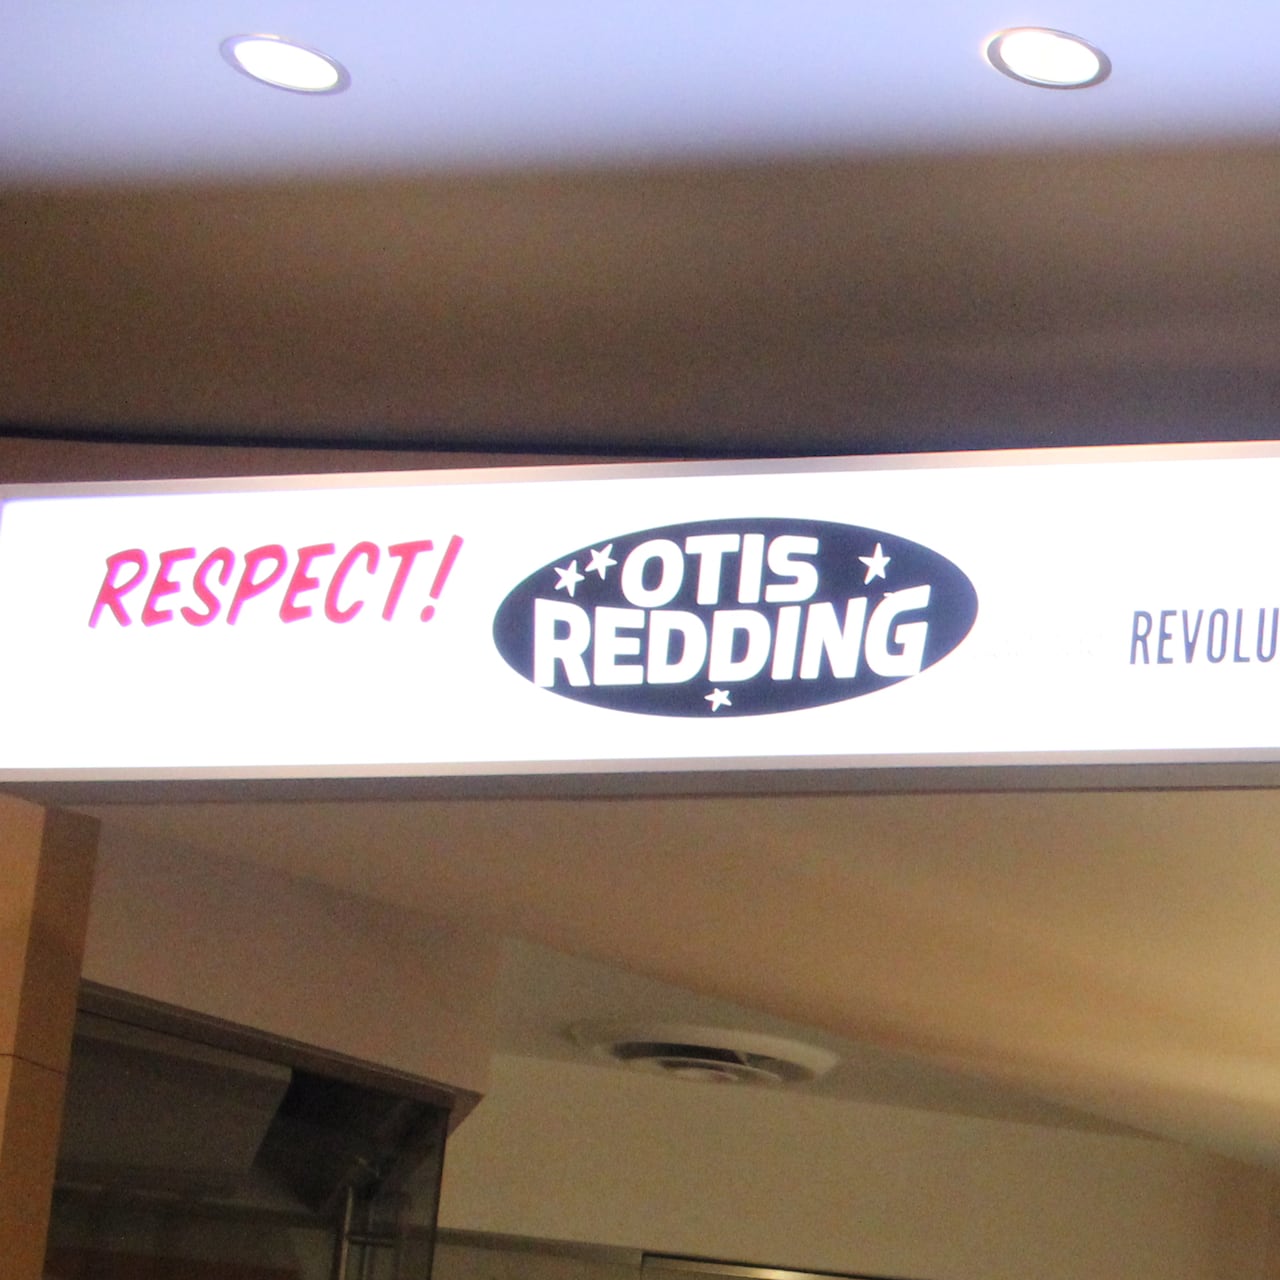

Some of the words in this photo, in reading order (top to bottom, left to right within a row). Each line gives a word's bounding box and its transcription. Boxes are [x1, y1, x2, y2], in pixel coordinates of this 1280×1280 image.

[88, 535, 464, 629] RESPECT!
[621, 533, 821, 607] OTIS
[531, 582, 931, 687] REDDING
